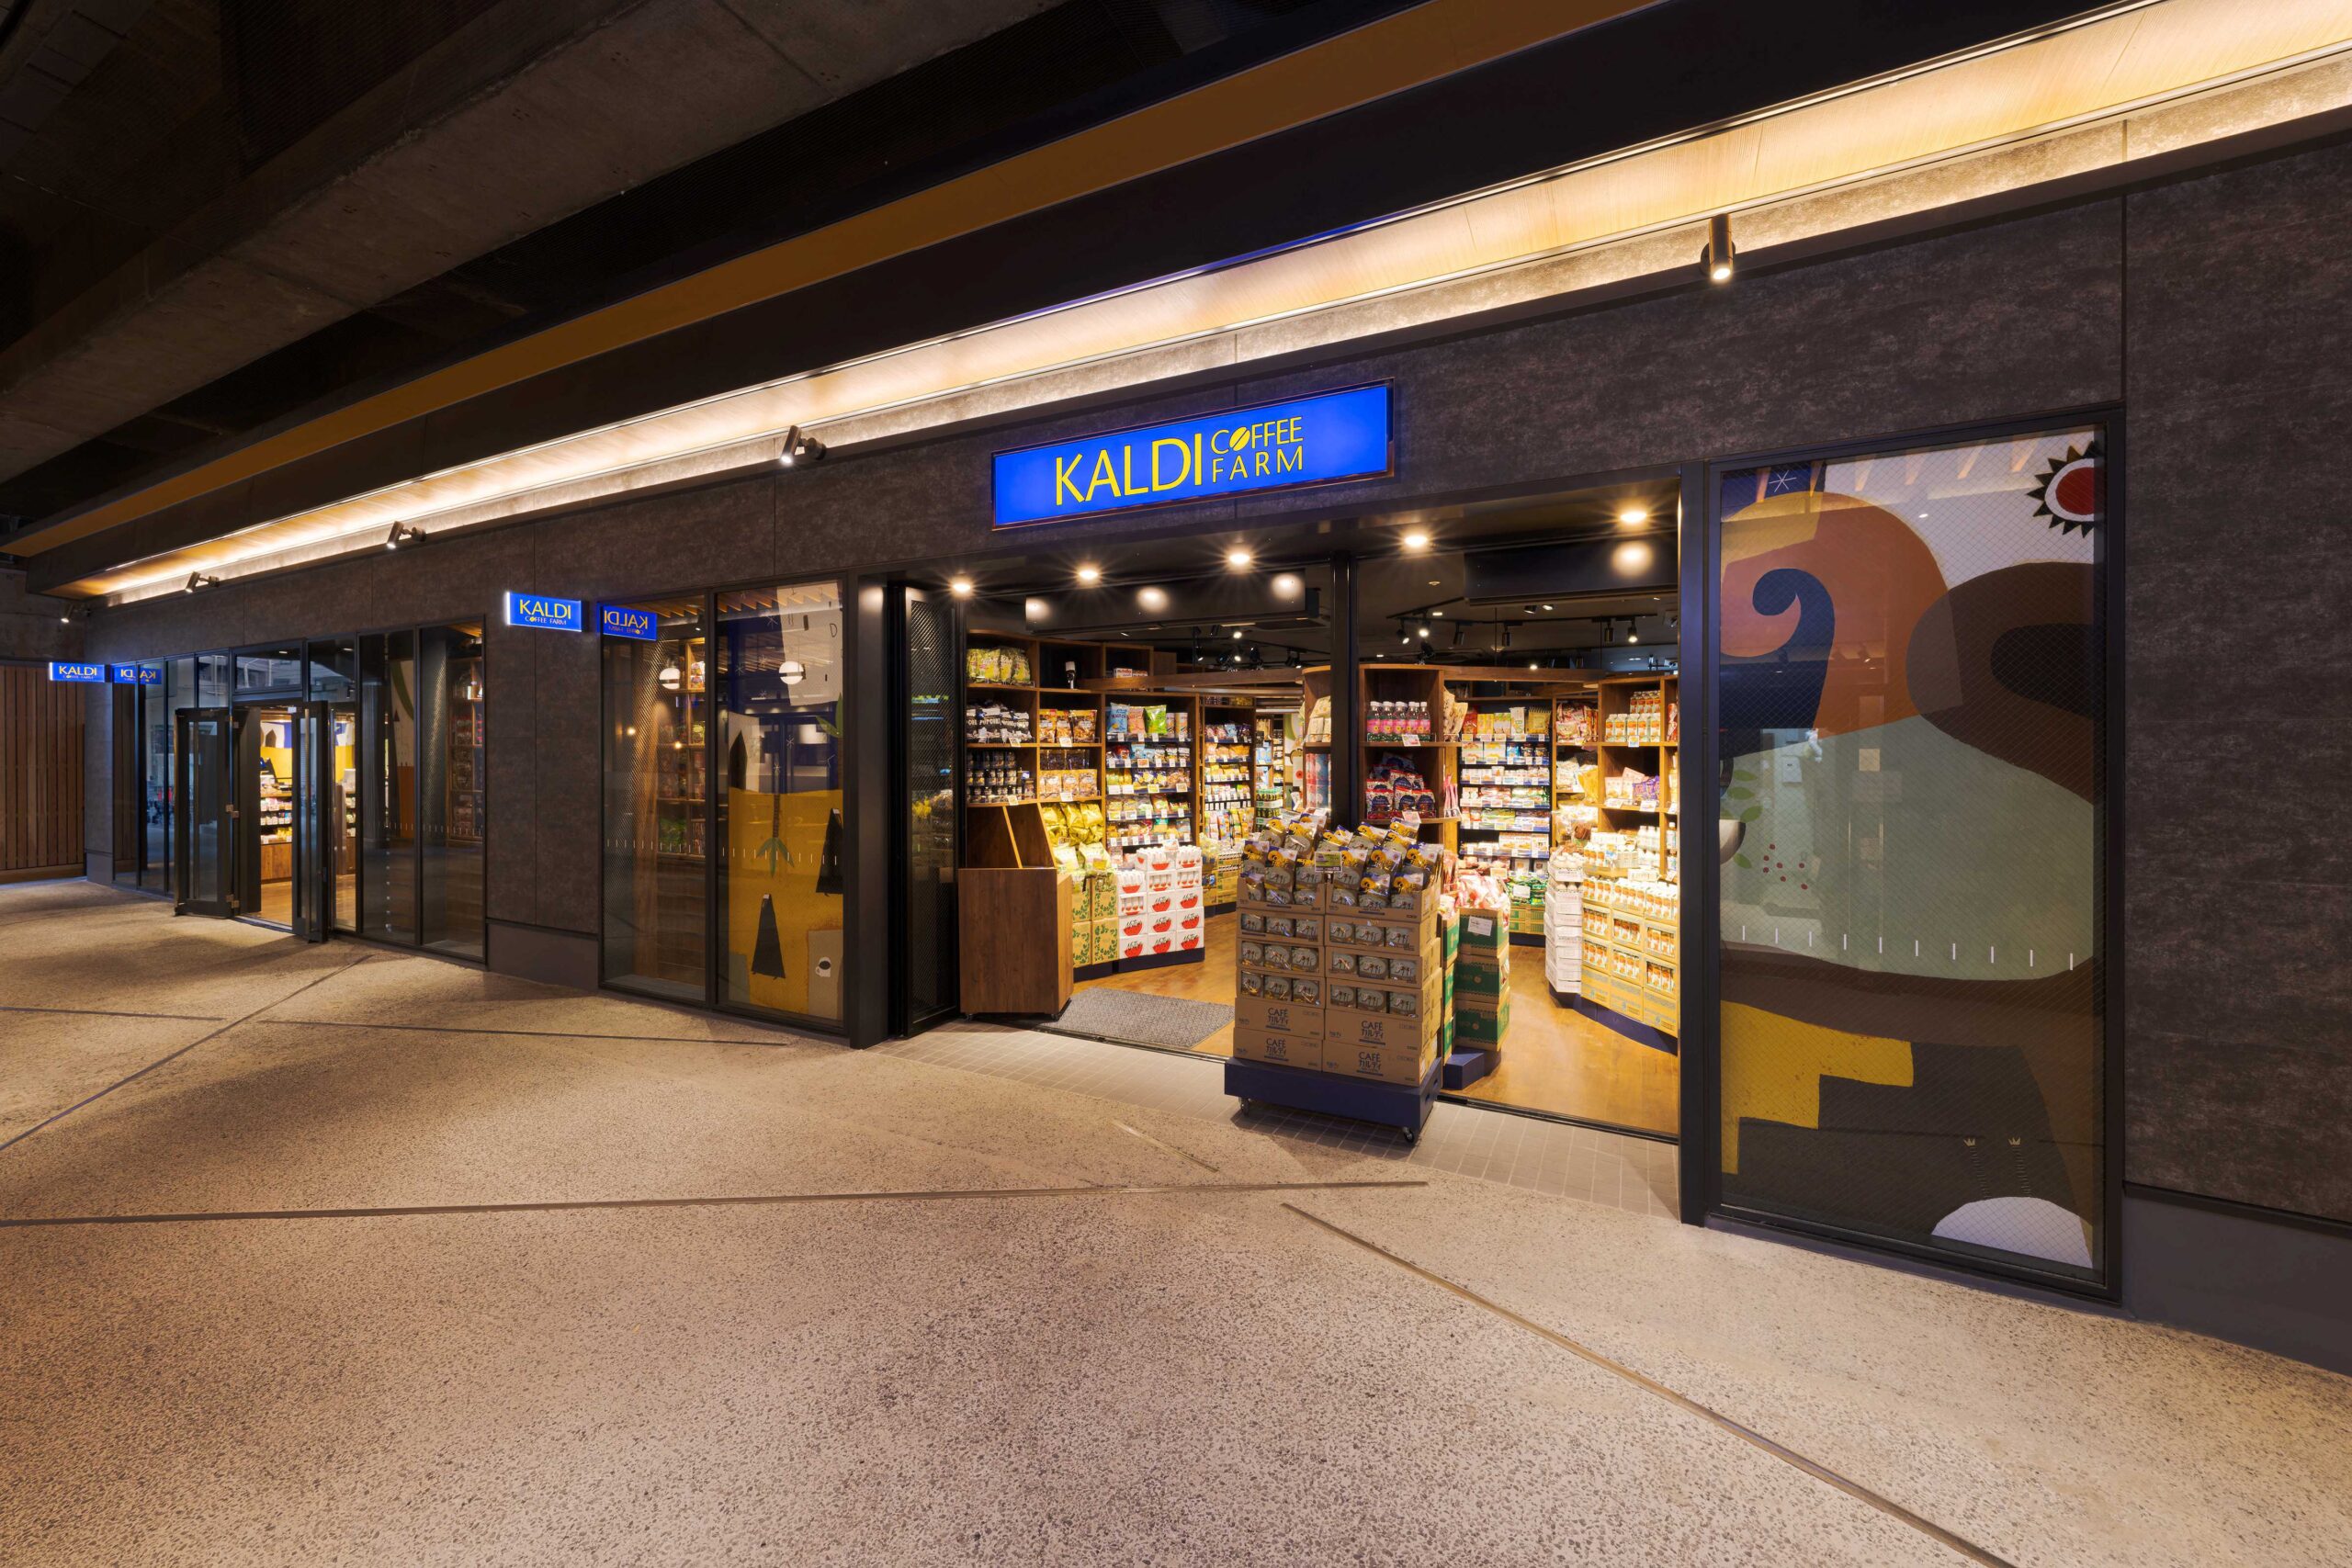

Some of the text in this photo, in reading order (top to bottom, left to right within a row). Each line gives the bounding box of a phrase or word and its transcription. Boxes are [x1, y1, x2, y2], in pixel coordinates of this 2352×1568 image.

[1210, 416, 1304, 455] COFFEE
[1056, 433, 1202, 506] KALDI
[1212, 446, 1303, 483] FARM
[519, 599, 571, 620] KALDI
[59, 666, 97, 676] KALDI
